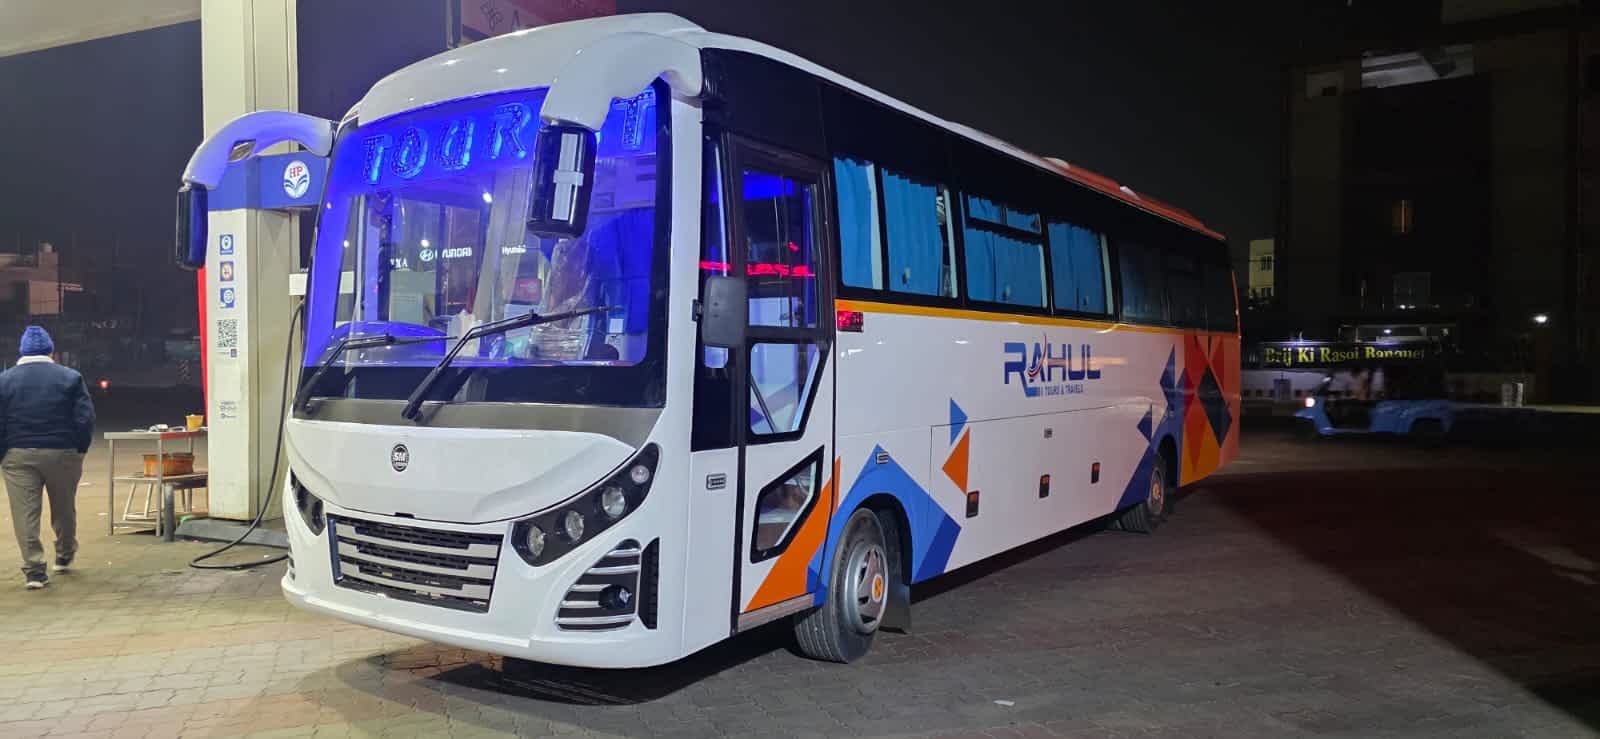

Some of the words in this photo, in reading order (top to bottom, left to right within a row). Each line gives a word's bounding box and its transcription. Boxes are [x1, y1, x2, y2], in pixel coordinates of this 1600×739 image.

[361, 88, 656, 185] TOURT
[290, 166, 303, 177] HP
[1004, 341, 1101, 397] RAHUL
[1297, 347, 1315, 363] Ki
[1319, 346, 1360, 363] Rasoi
